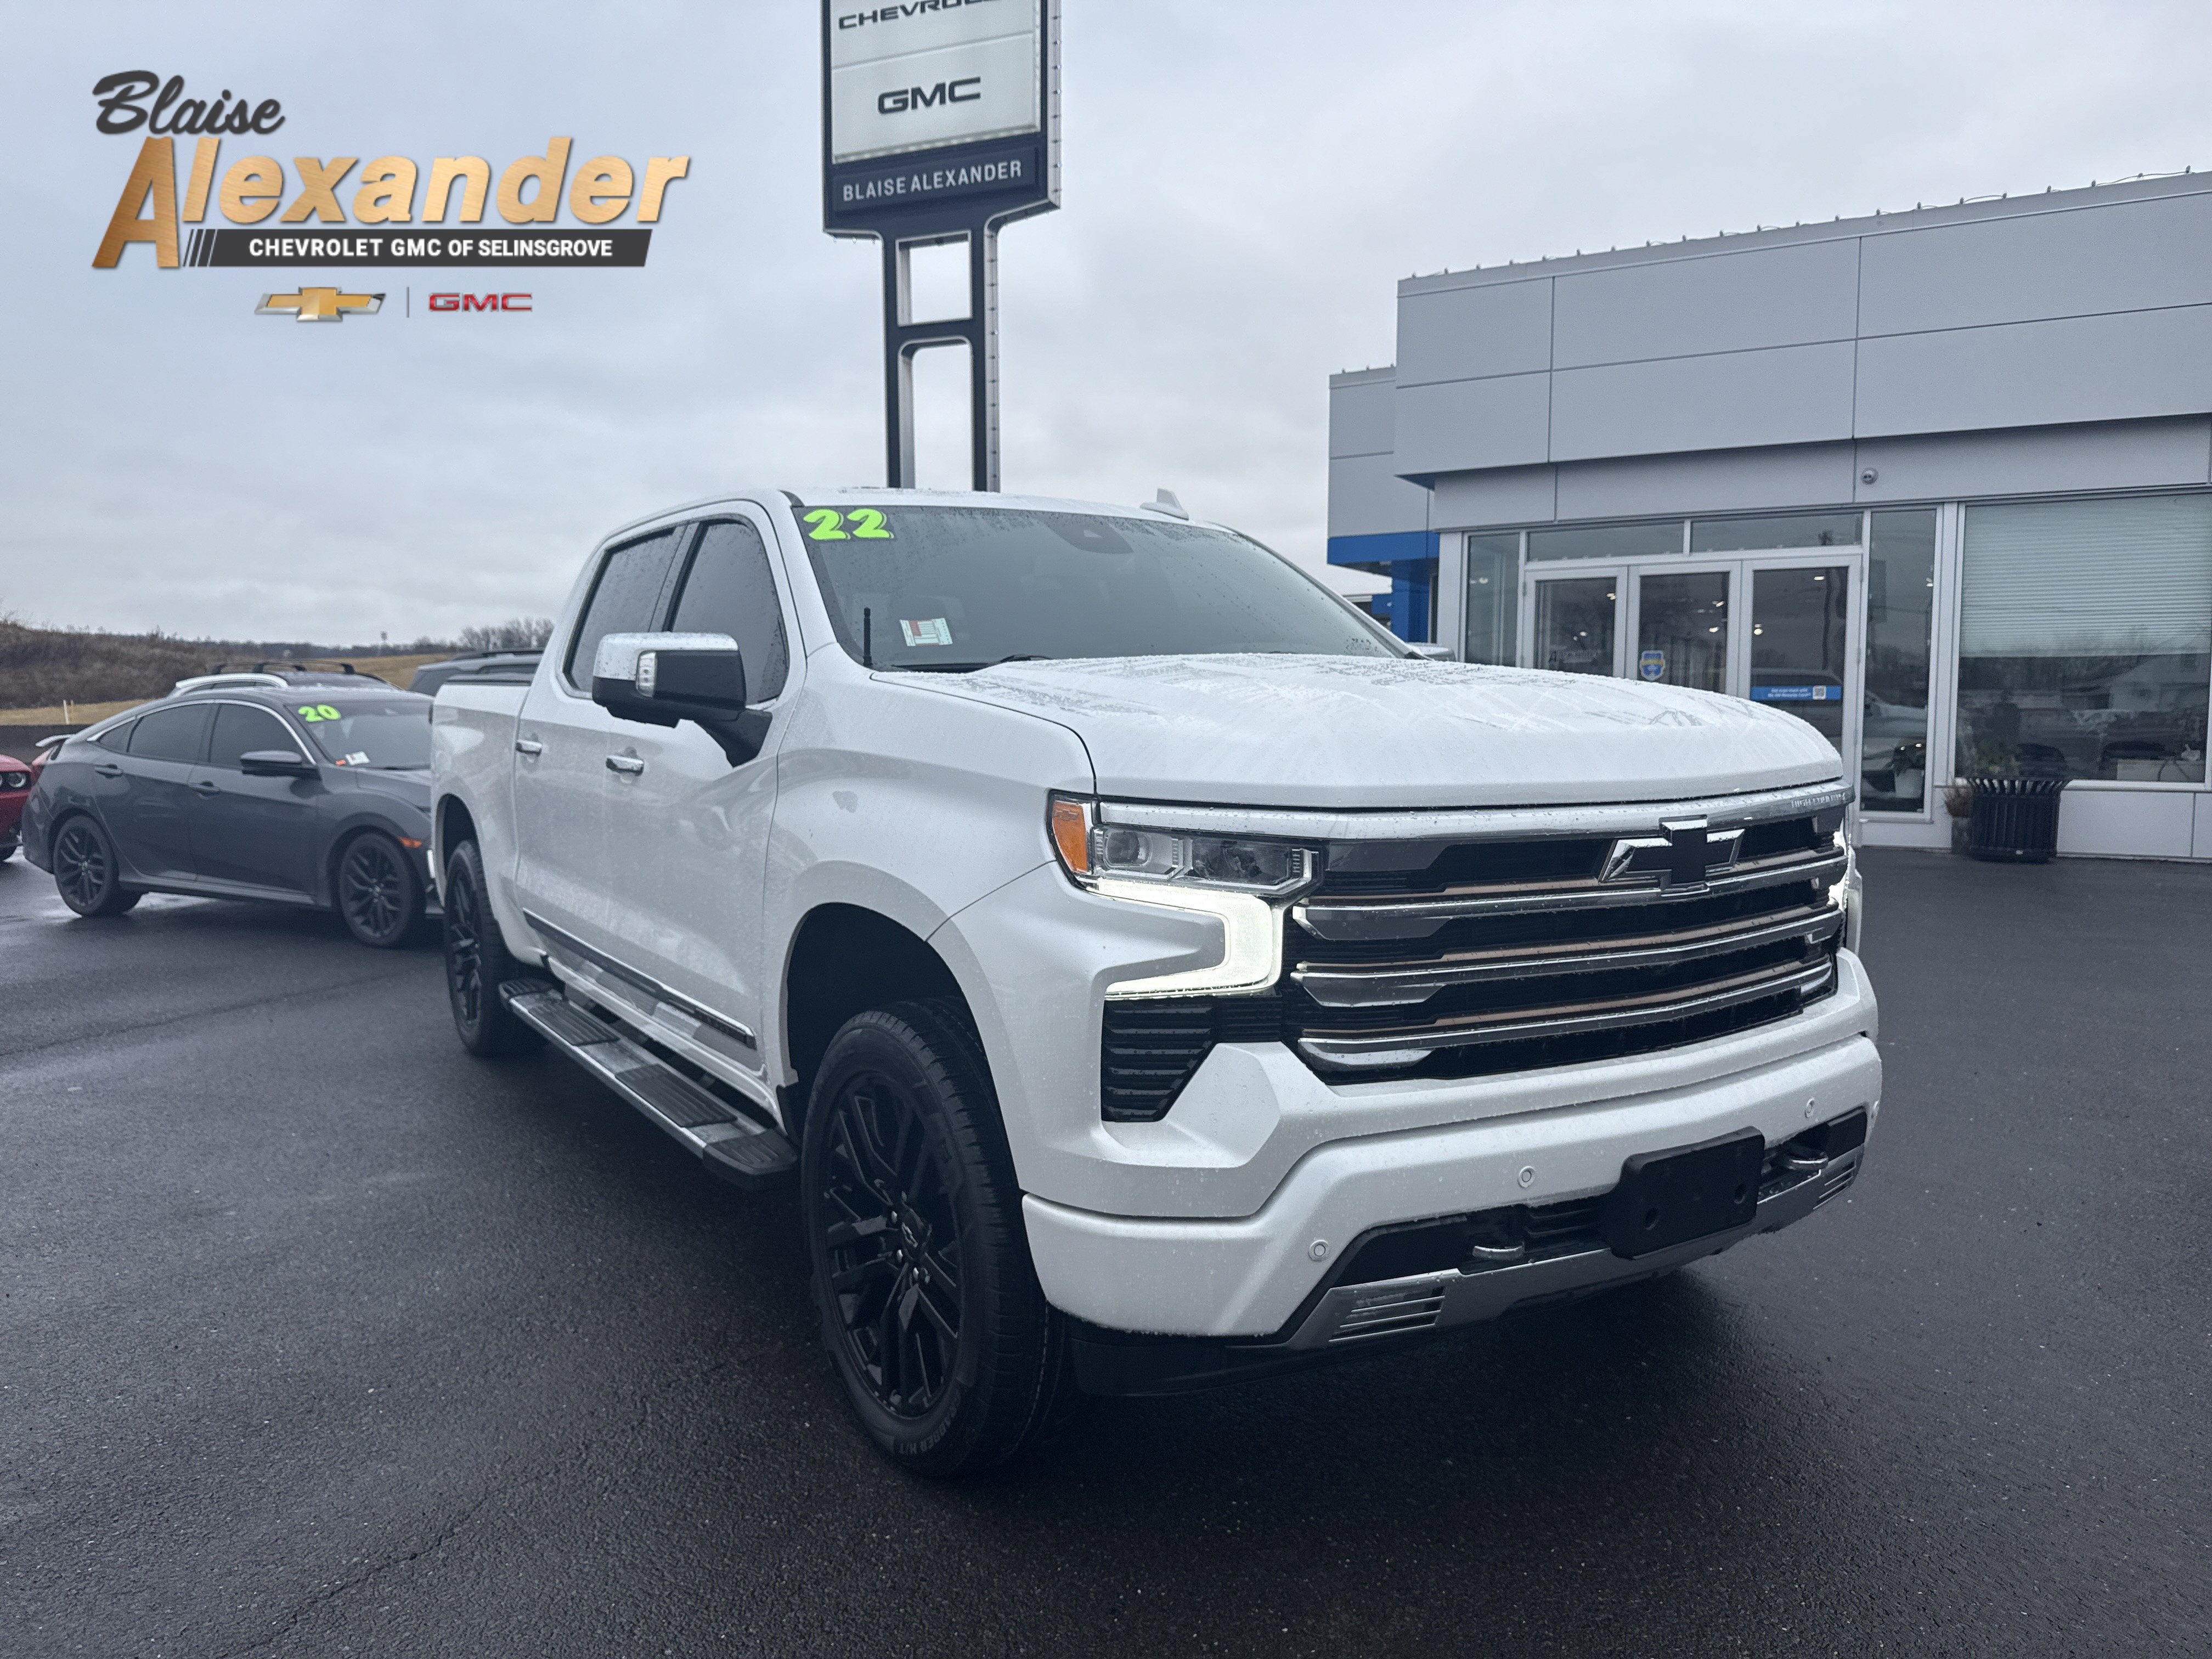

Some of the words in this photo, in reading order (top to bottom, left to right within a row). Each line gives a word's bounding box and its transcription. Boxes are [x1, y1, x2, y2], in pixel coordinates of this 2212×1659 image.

[838, 0, 1000, 30] CHEVRO
[878, 76, 981, 114] GMC
[843, 177, 906, 201] BLAISE
[911, 160, 1022, 193] ALEXANDER
[803, 508, 894, 540] 22
[298, 704, 341, 723] 20
